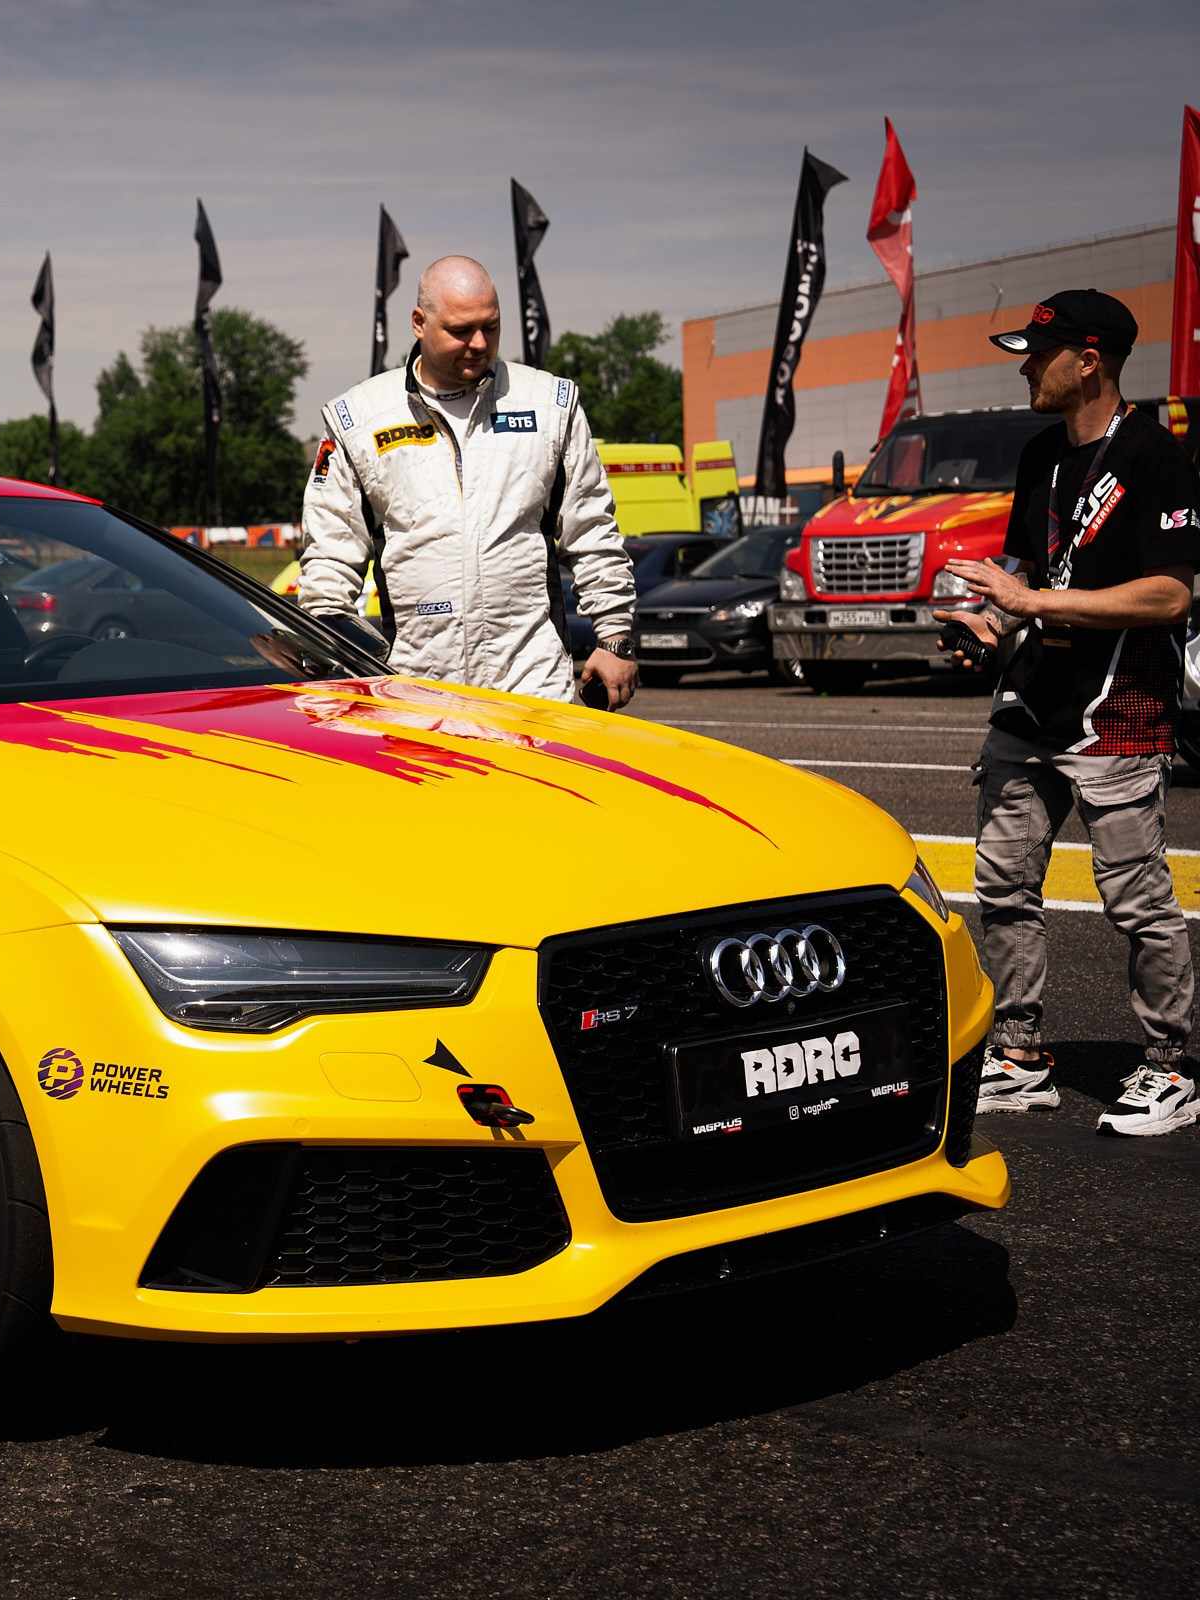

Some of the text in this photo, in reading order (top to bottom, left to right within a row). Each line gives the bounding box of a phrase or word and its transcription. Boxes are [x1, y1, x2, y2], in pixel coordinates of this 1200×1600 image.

[508, 415, 533, 428] ВТБ
[1105, 415, 1121, 438] RDRC
[374, 424, 435, 448] RDRC
[1072, 497, 1086, 521] RDRC
[1091, 488, 1122, 531] SERVICE
[92, 1063, 163, 1083] POWER
[741, 1031, 861, 1097] RDRC
[90, 1078, 170, 1100] WHEELS
[871, 1081, 909, 1098] VAGPLUS
[693, 1117, 742, 1135] VAGPLUS
